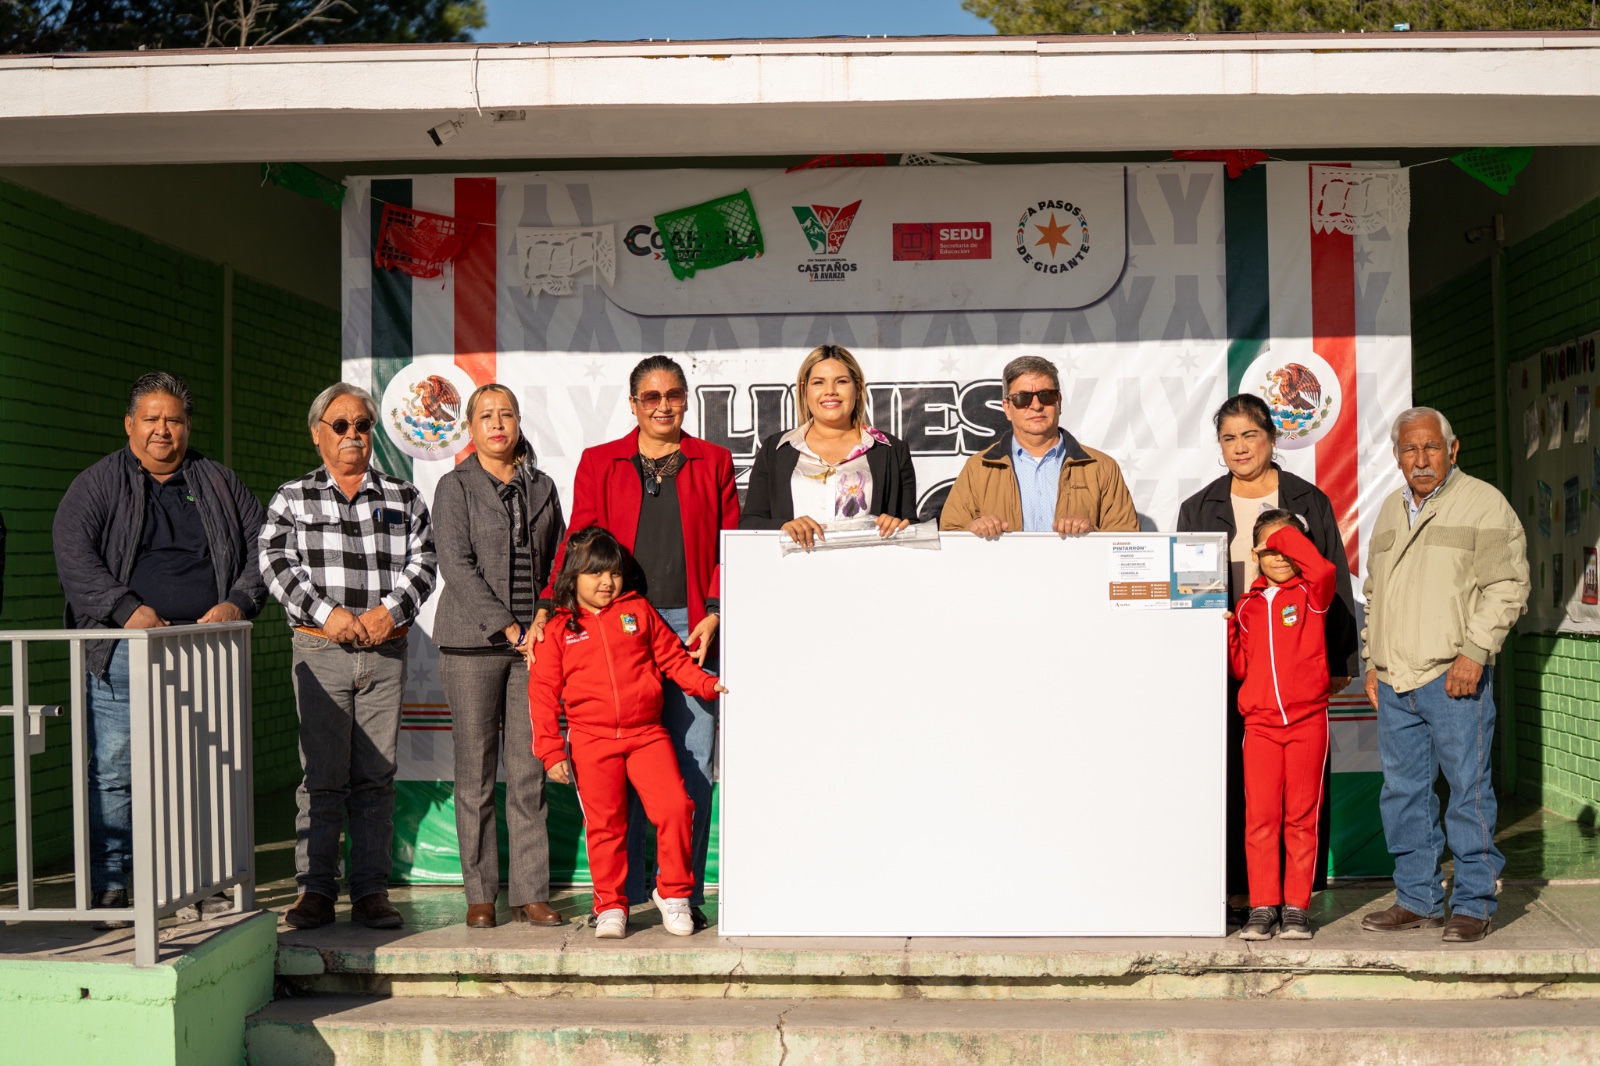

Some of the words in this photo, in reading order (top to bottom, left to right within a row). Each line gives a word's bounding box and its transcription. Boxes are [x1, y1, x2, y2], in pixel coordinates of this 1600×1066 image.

[1027, 207, 1037, 217] A
[1037, 200, 1082, 216] PASOS
[939, 228, 984, 241] SEDU
[1016, 245, 1033, 263] DE
[1034, 244, 1090, 274] GIGANTE
[798, 262, 857, 272] CASTAÑOS
[809, 272, 819, 280] YA
